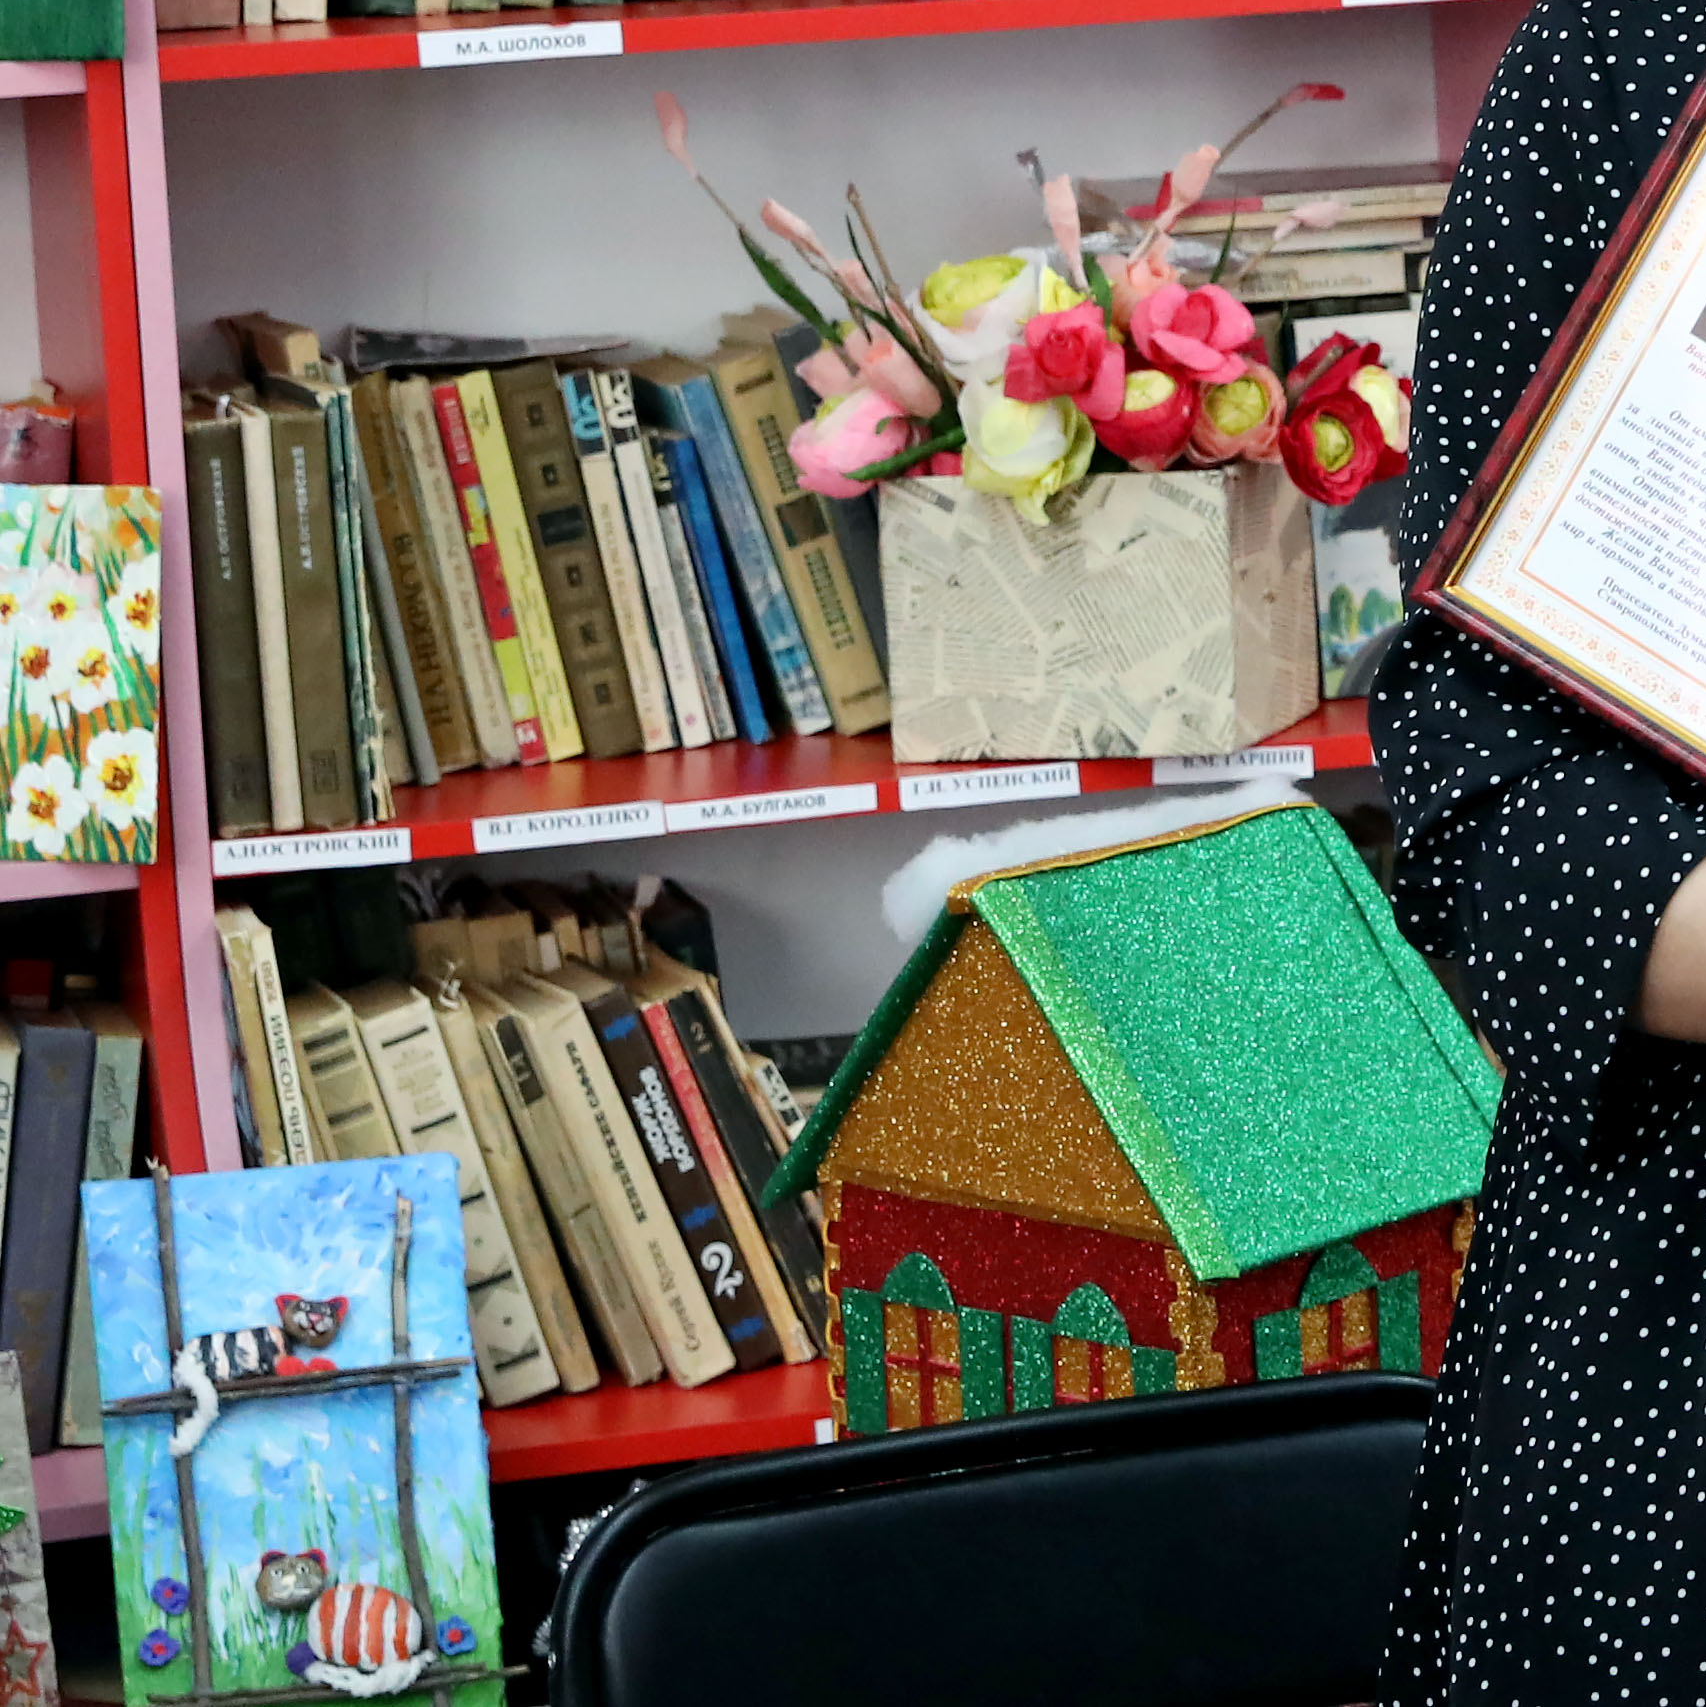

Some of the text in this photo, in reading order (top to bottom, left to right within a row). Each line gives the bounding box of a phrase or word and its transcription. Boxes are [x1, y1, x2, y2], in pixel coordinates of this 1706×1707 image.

[456, 34, 587, 55] М.А. ШОЛОХОВ
[1617, 415, 1702, 470] многолетний
[1645, 415, 1697, 449] личный
[1587, 468, 1649, 509] внимания
[1572, 492, 1655, 547] достижений
[1594, 587, 1690, 652] Ставропольского
[1601, 575, 1677, 628] Председатель
[951, 765, 1073, 793] УСПЕНСКИЙ
[1225, 748, 1306, 768] ГАРШИН
[529, 809, 651, 837] КОРОЛЕНКО
[700, 794, 827, 821] М.А. БУЛГАКОВ
[271, 1013, 297, 1101] ПОЭЗИИ
[564, 1039, 599, 1110] САФАРИ
[632, 1093, 672, 1165] ЖОРЖ
[639, 1065, 696, 1174] БОРДОНОВ
[594, 1110, 648, 1225] КЕНИЙСКИЕ
